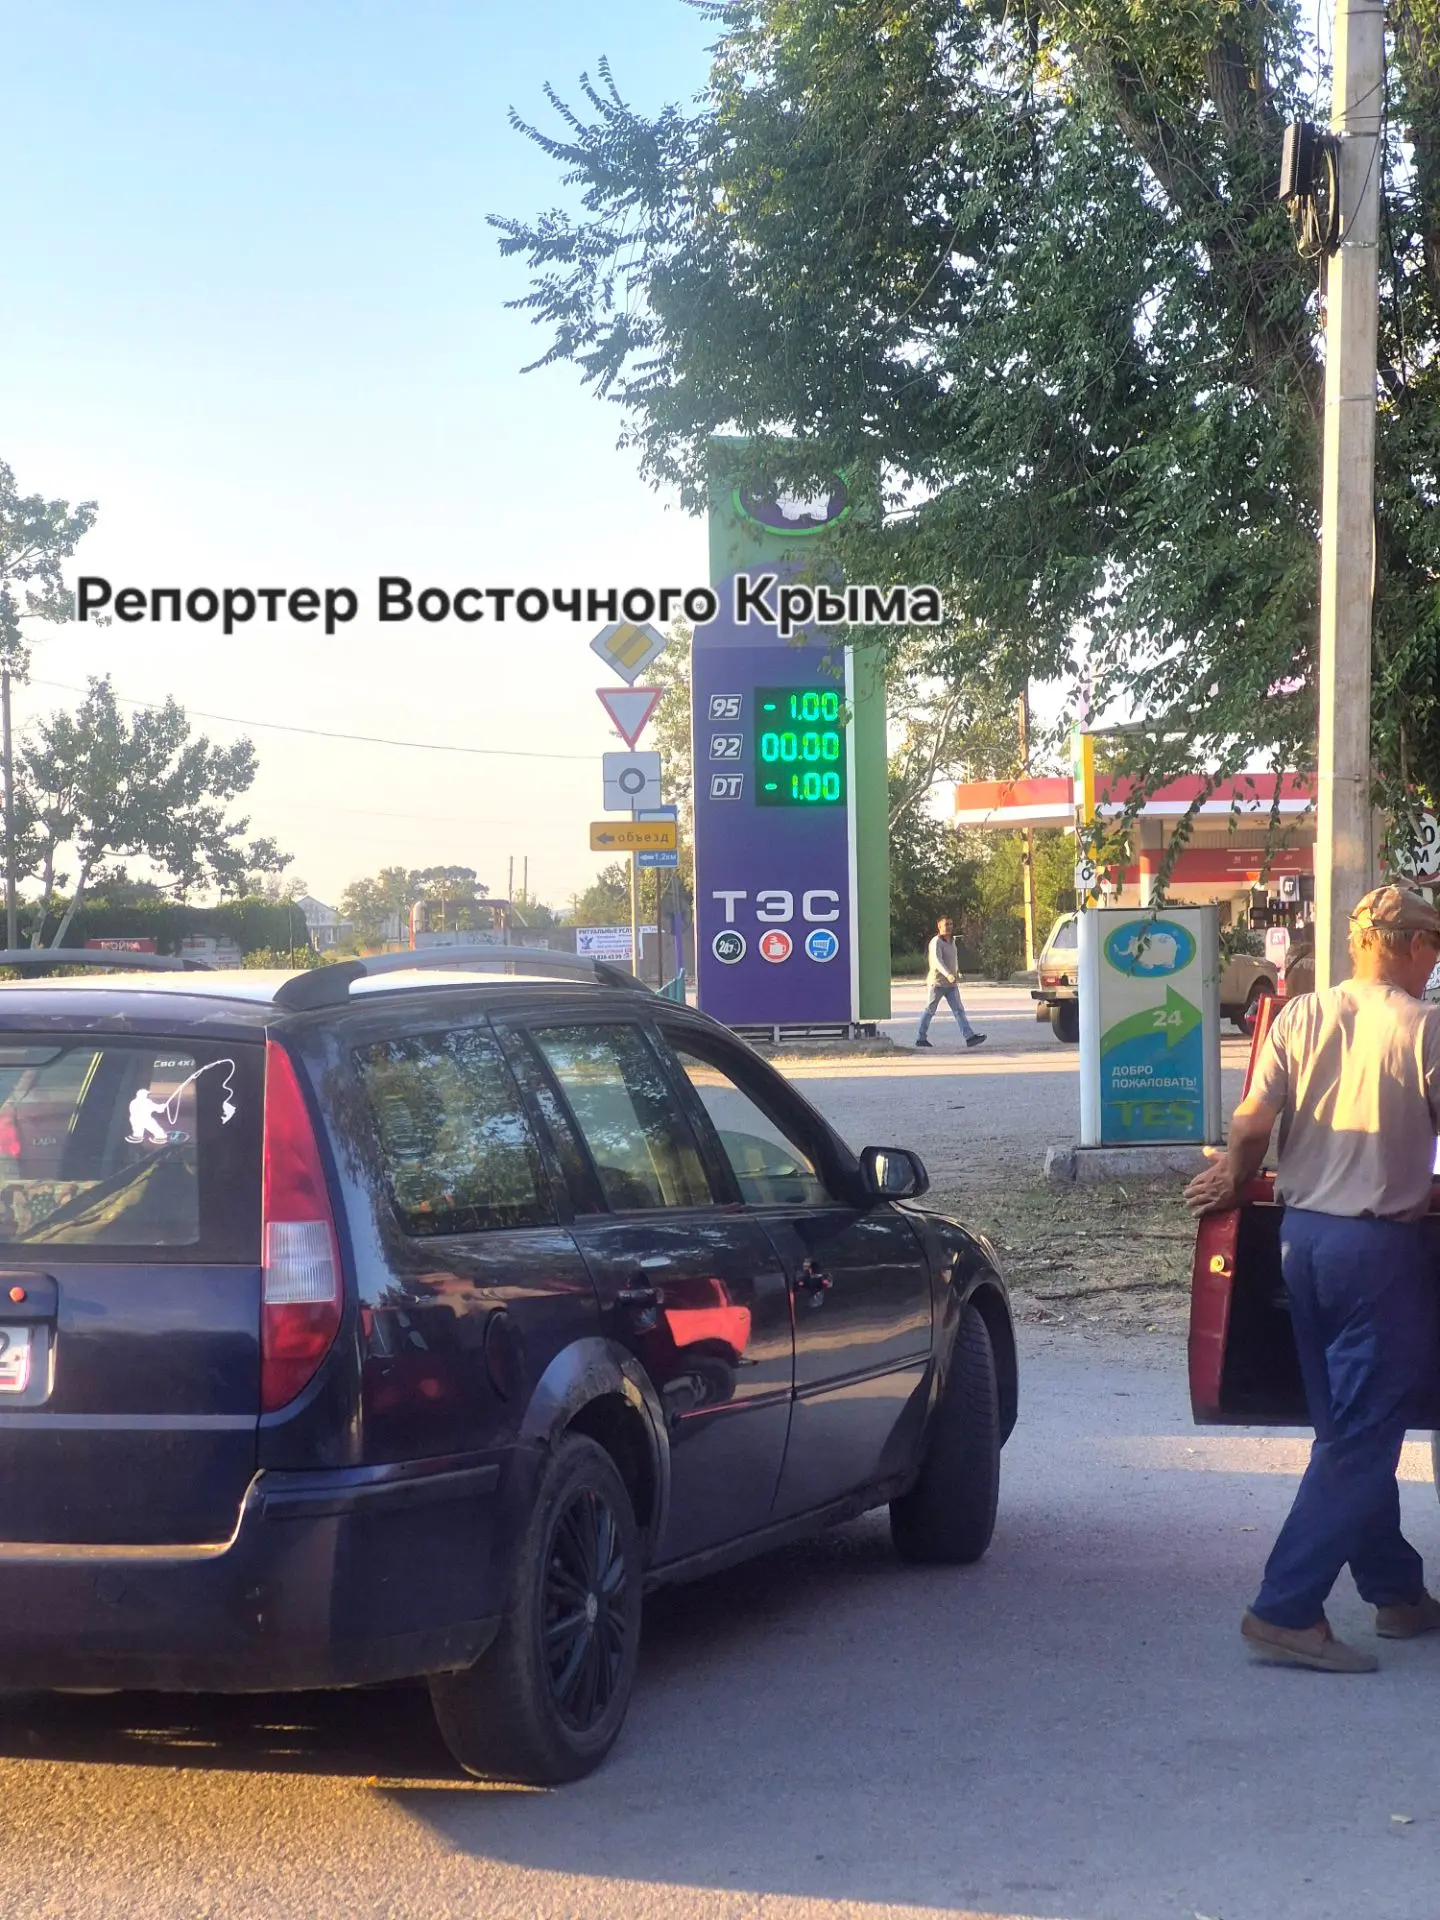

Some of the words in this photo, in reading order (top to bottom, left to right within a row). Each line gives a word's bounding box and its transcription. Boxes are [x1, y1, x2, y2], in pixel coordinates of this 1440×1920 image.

[712, 698, 739, 717] 95
[713, 737, 740, 756] 92
[761, 732, 840, 761] 00.00
[618, 832, 669, 843] объезд
[712, 890, 840, 923] ТЭС
[1153, 1010, 1184, 1027] 24
[1112, 1065, 1153, 1077] ДОБРО
[1112, 1077, 1197, 1089] ПОЖАЛОВАТЬ!
[1112, 1099, 1193, 1126] TES
